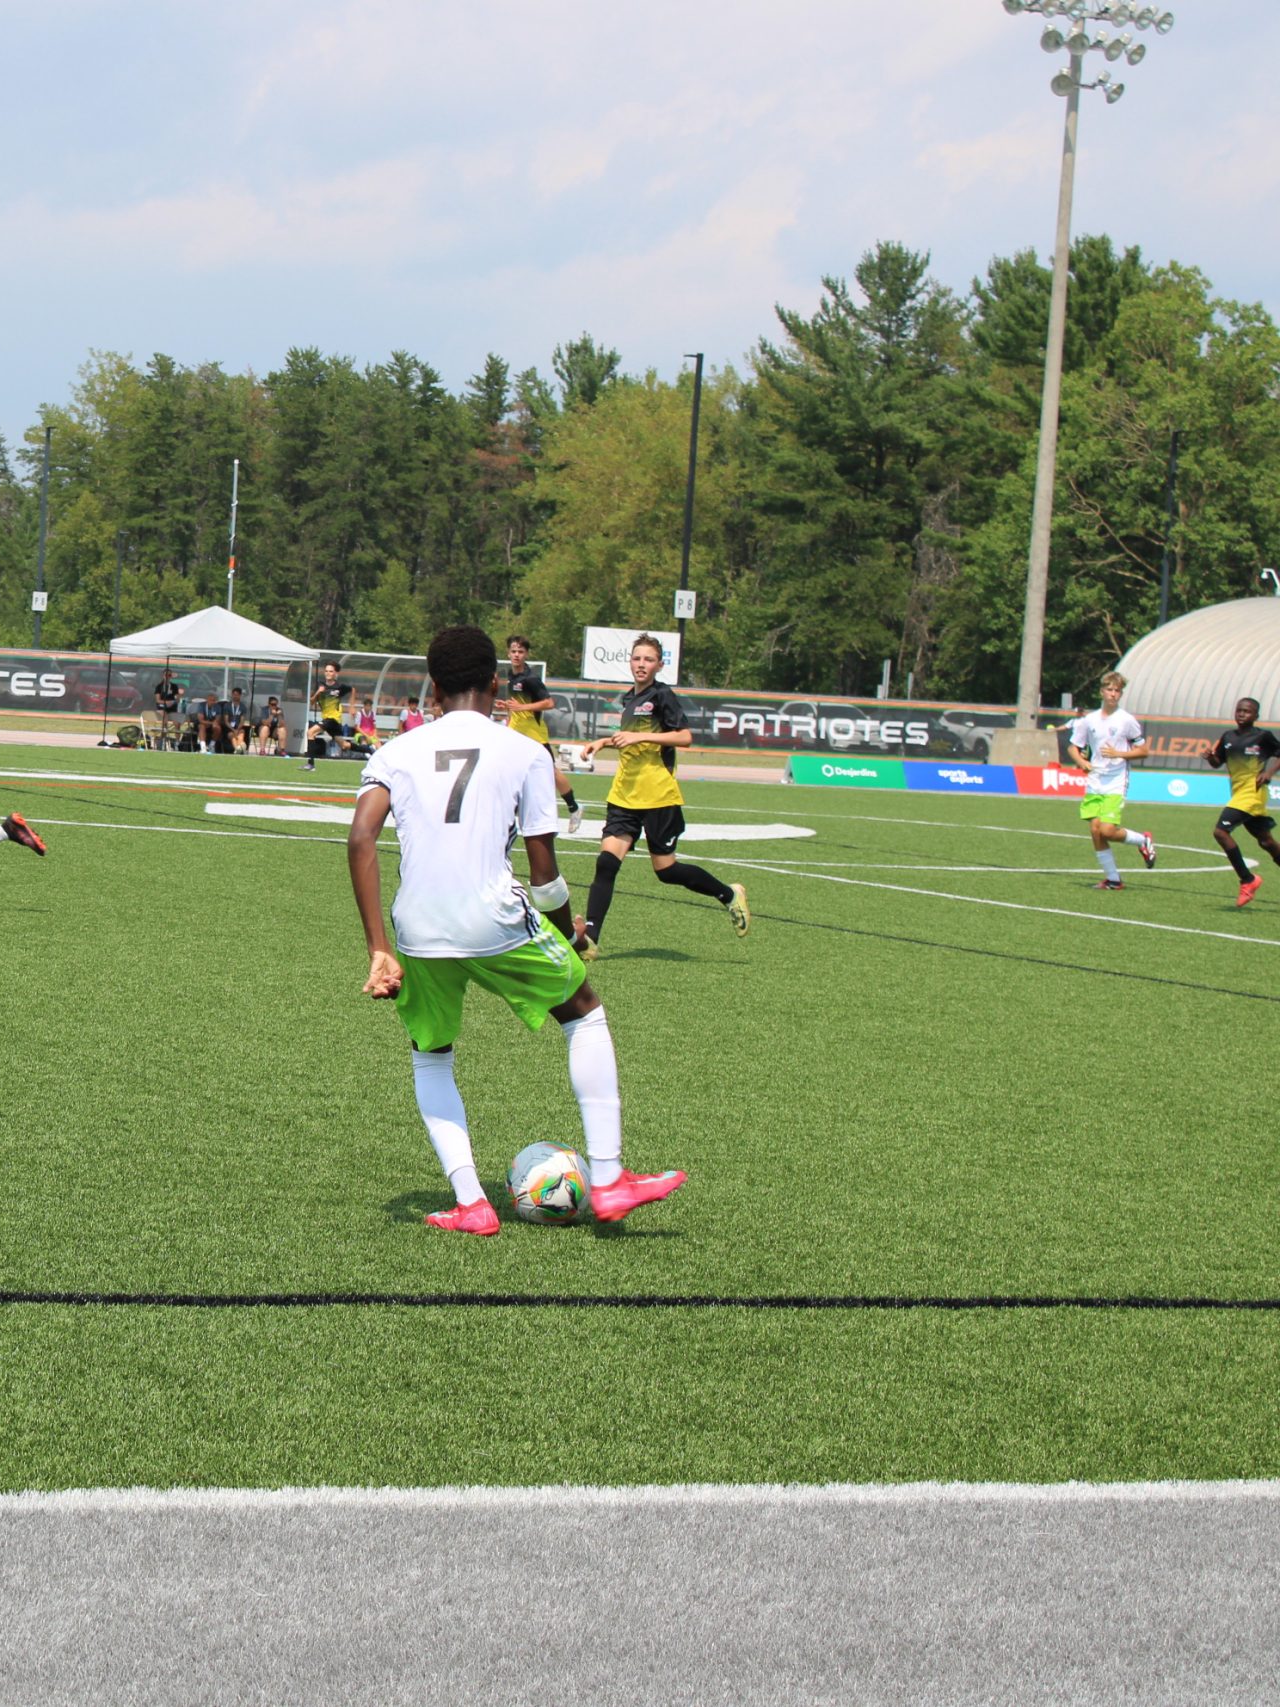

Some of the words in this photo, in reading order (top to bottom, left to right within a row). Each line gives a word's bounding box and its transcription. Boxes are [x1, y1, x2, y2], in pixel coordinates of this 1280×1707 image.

[712, 711, 930, 746] PATRIOTES
[435, 747, 481, 824] 7
[835, 767, 878, 777] Desjardins
